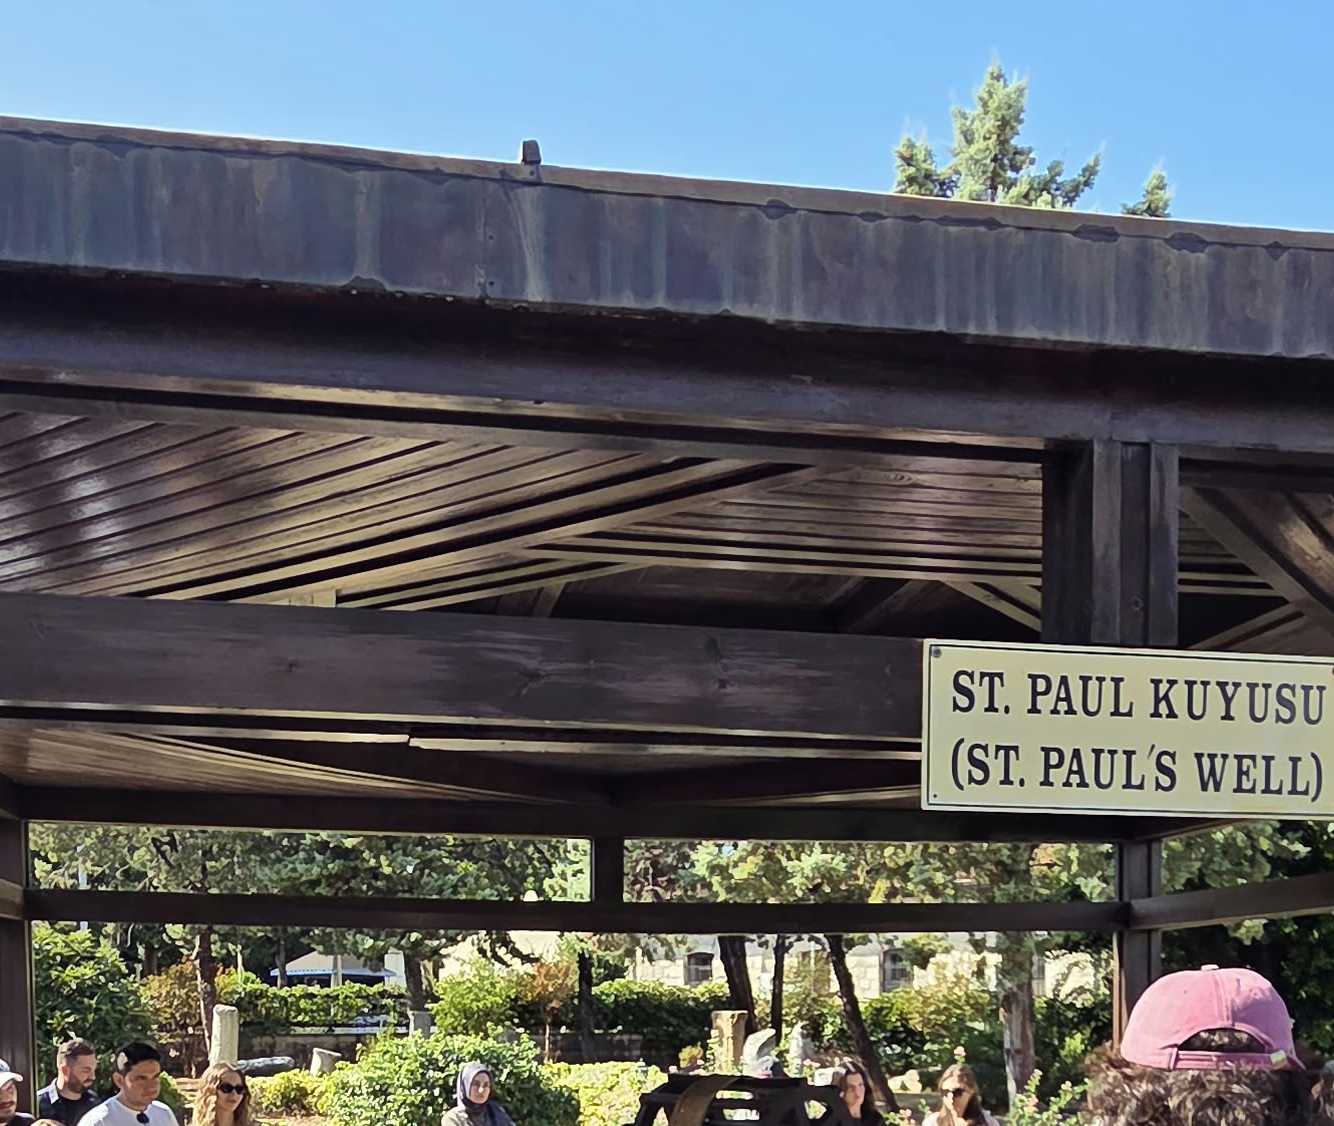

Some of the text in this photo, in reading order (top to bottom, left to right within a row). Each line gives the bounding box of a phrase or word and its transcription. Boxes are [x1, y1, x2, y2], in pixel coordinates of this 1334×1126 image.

[953, 670, 1327, 725] ST. PAUL KUYUSU
[952, 738, 1323, 803] (ST. PAUL'S WELL)
